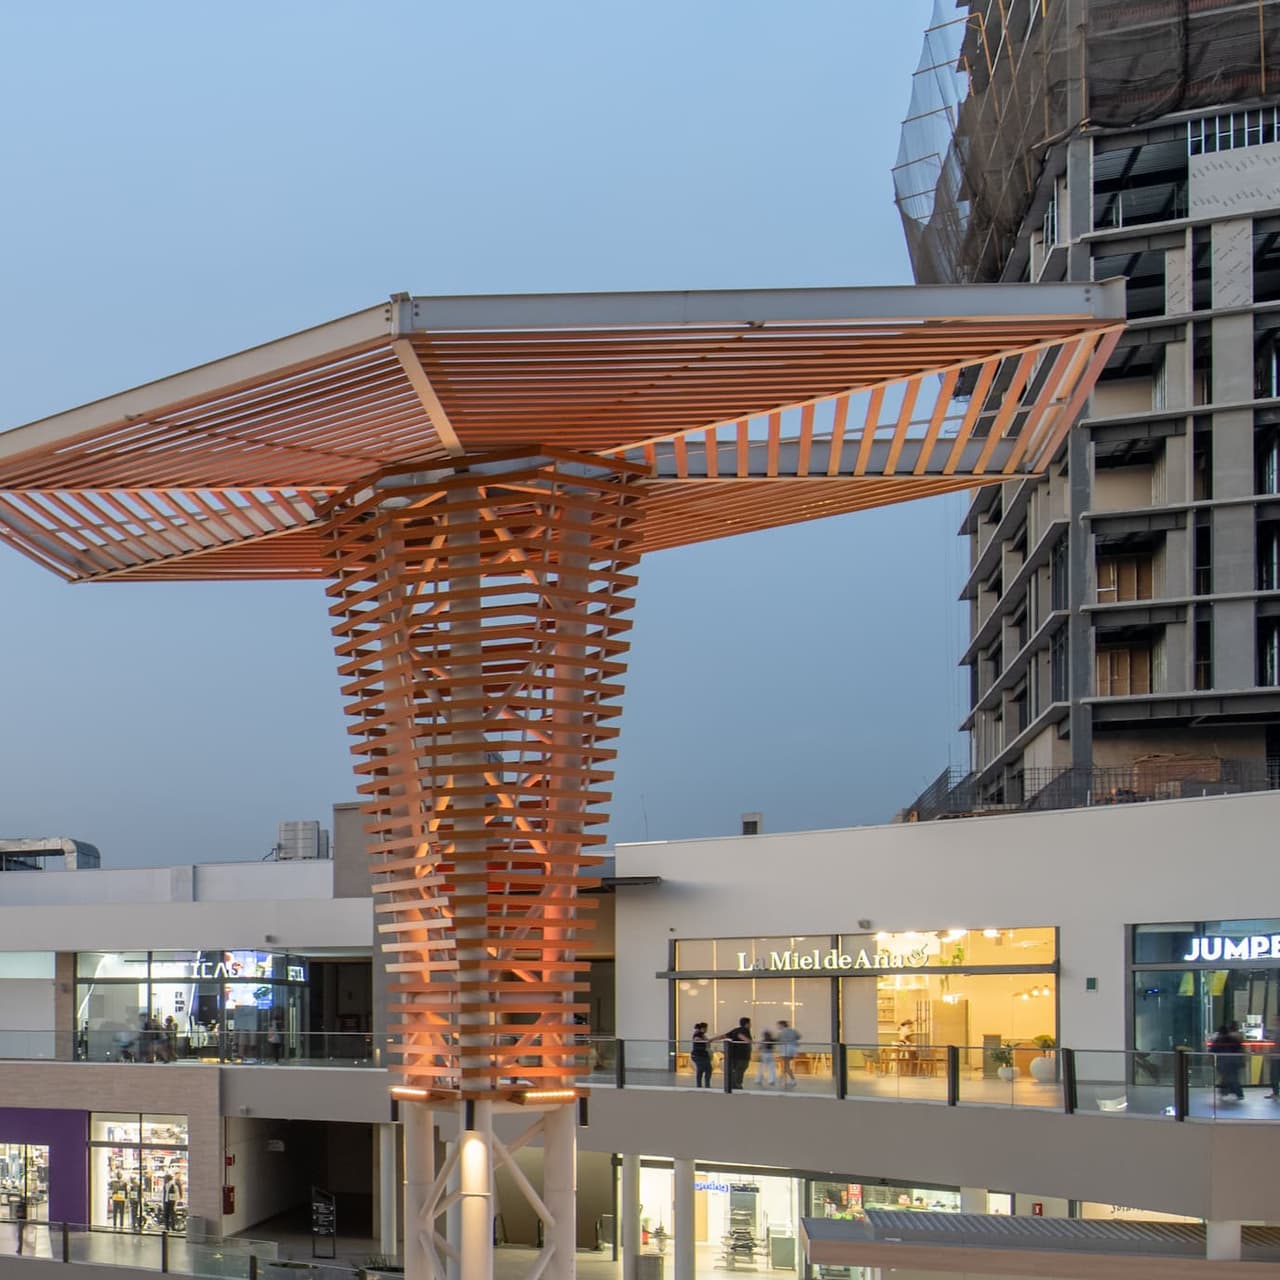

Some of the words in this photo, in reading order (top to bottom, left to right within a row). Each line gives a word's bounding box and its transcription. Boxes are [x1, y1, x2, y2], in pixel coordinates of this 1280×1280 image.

[738, 952, 766, 971] La
[770, 950, 821, 970] Miel
[824, 949, 852, 968] de
[854, 949, 904, 968] Ana
